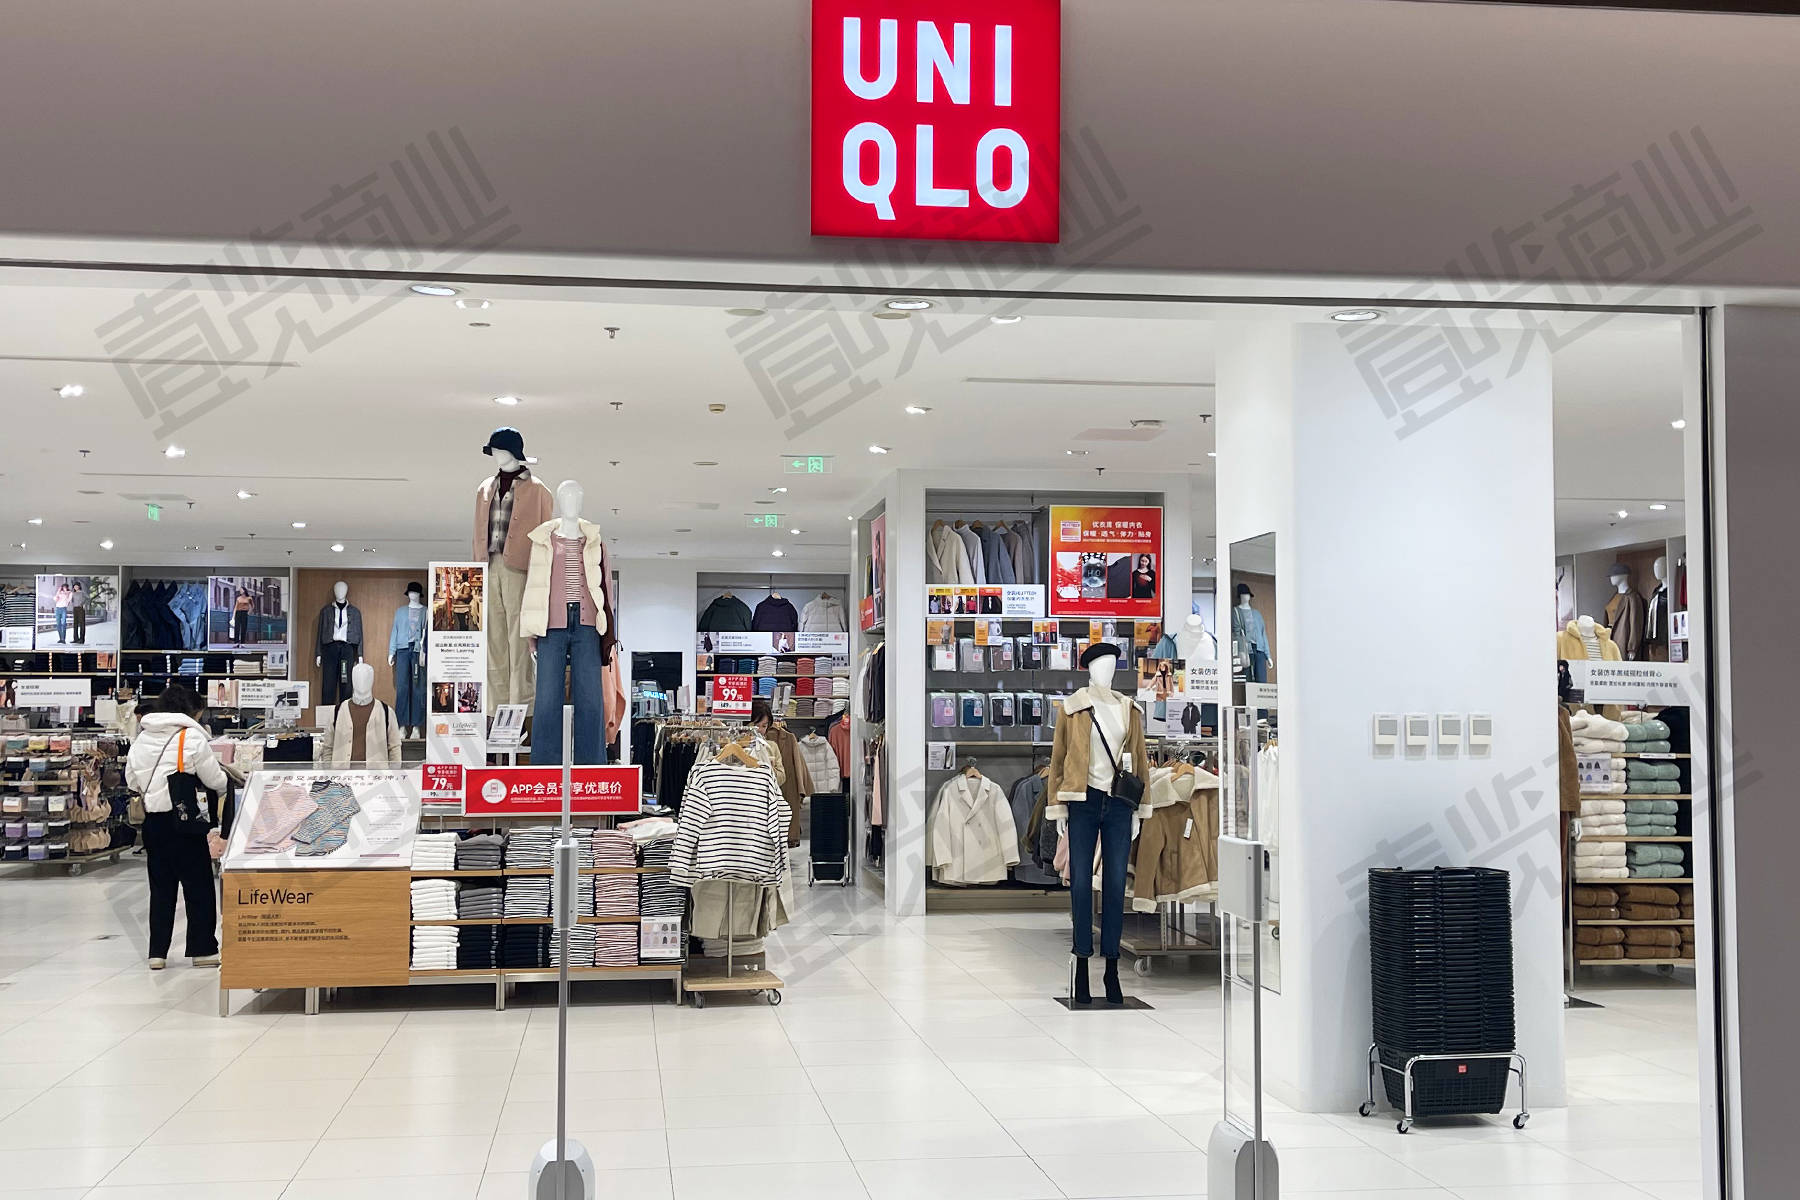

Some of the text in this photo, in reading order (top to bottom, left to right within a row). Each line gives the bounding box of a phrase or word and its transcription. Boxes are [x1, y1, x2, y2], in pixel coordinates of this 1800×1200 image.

[843, 17, 1012, 107] UNI
[843, 121, 1030, 221] QLO
[510, 781, 622, 795] APP会员享优惠价
[238, 888, 314, 905] LifeWear
